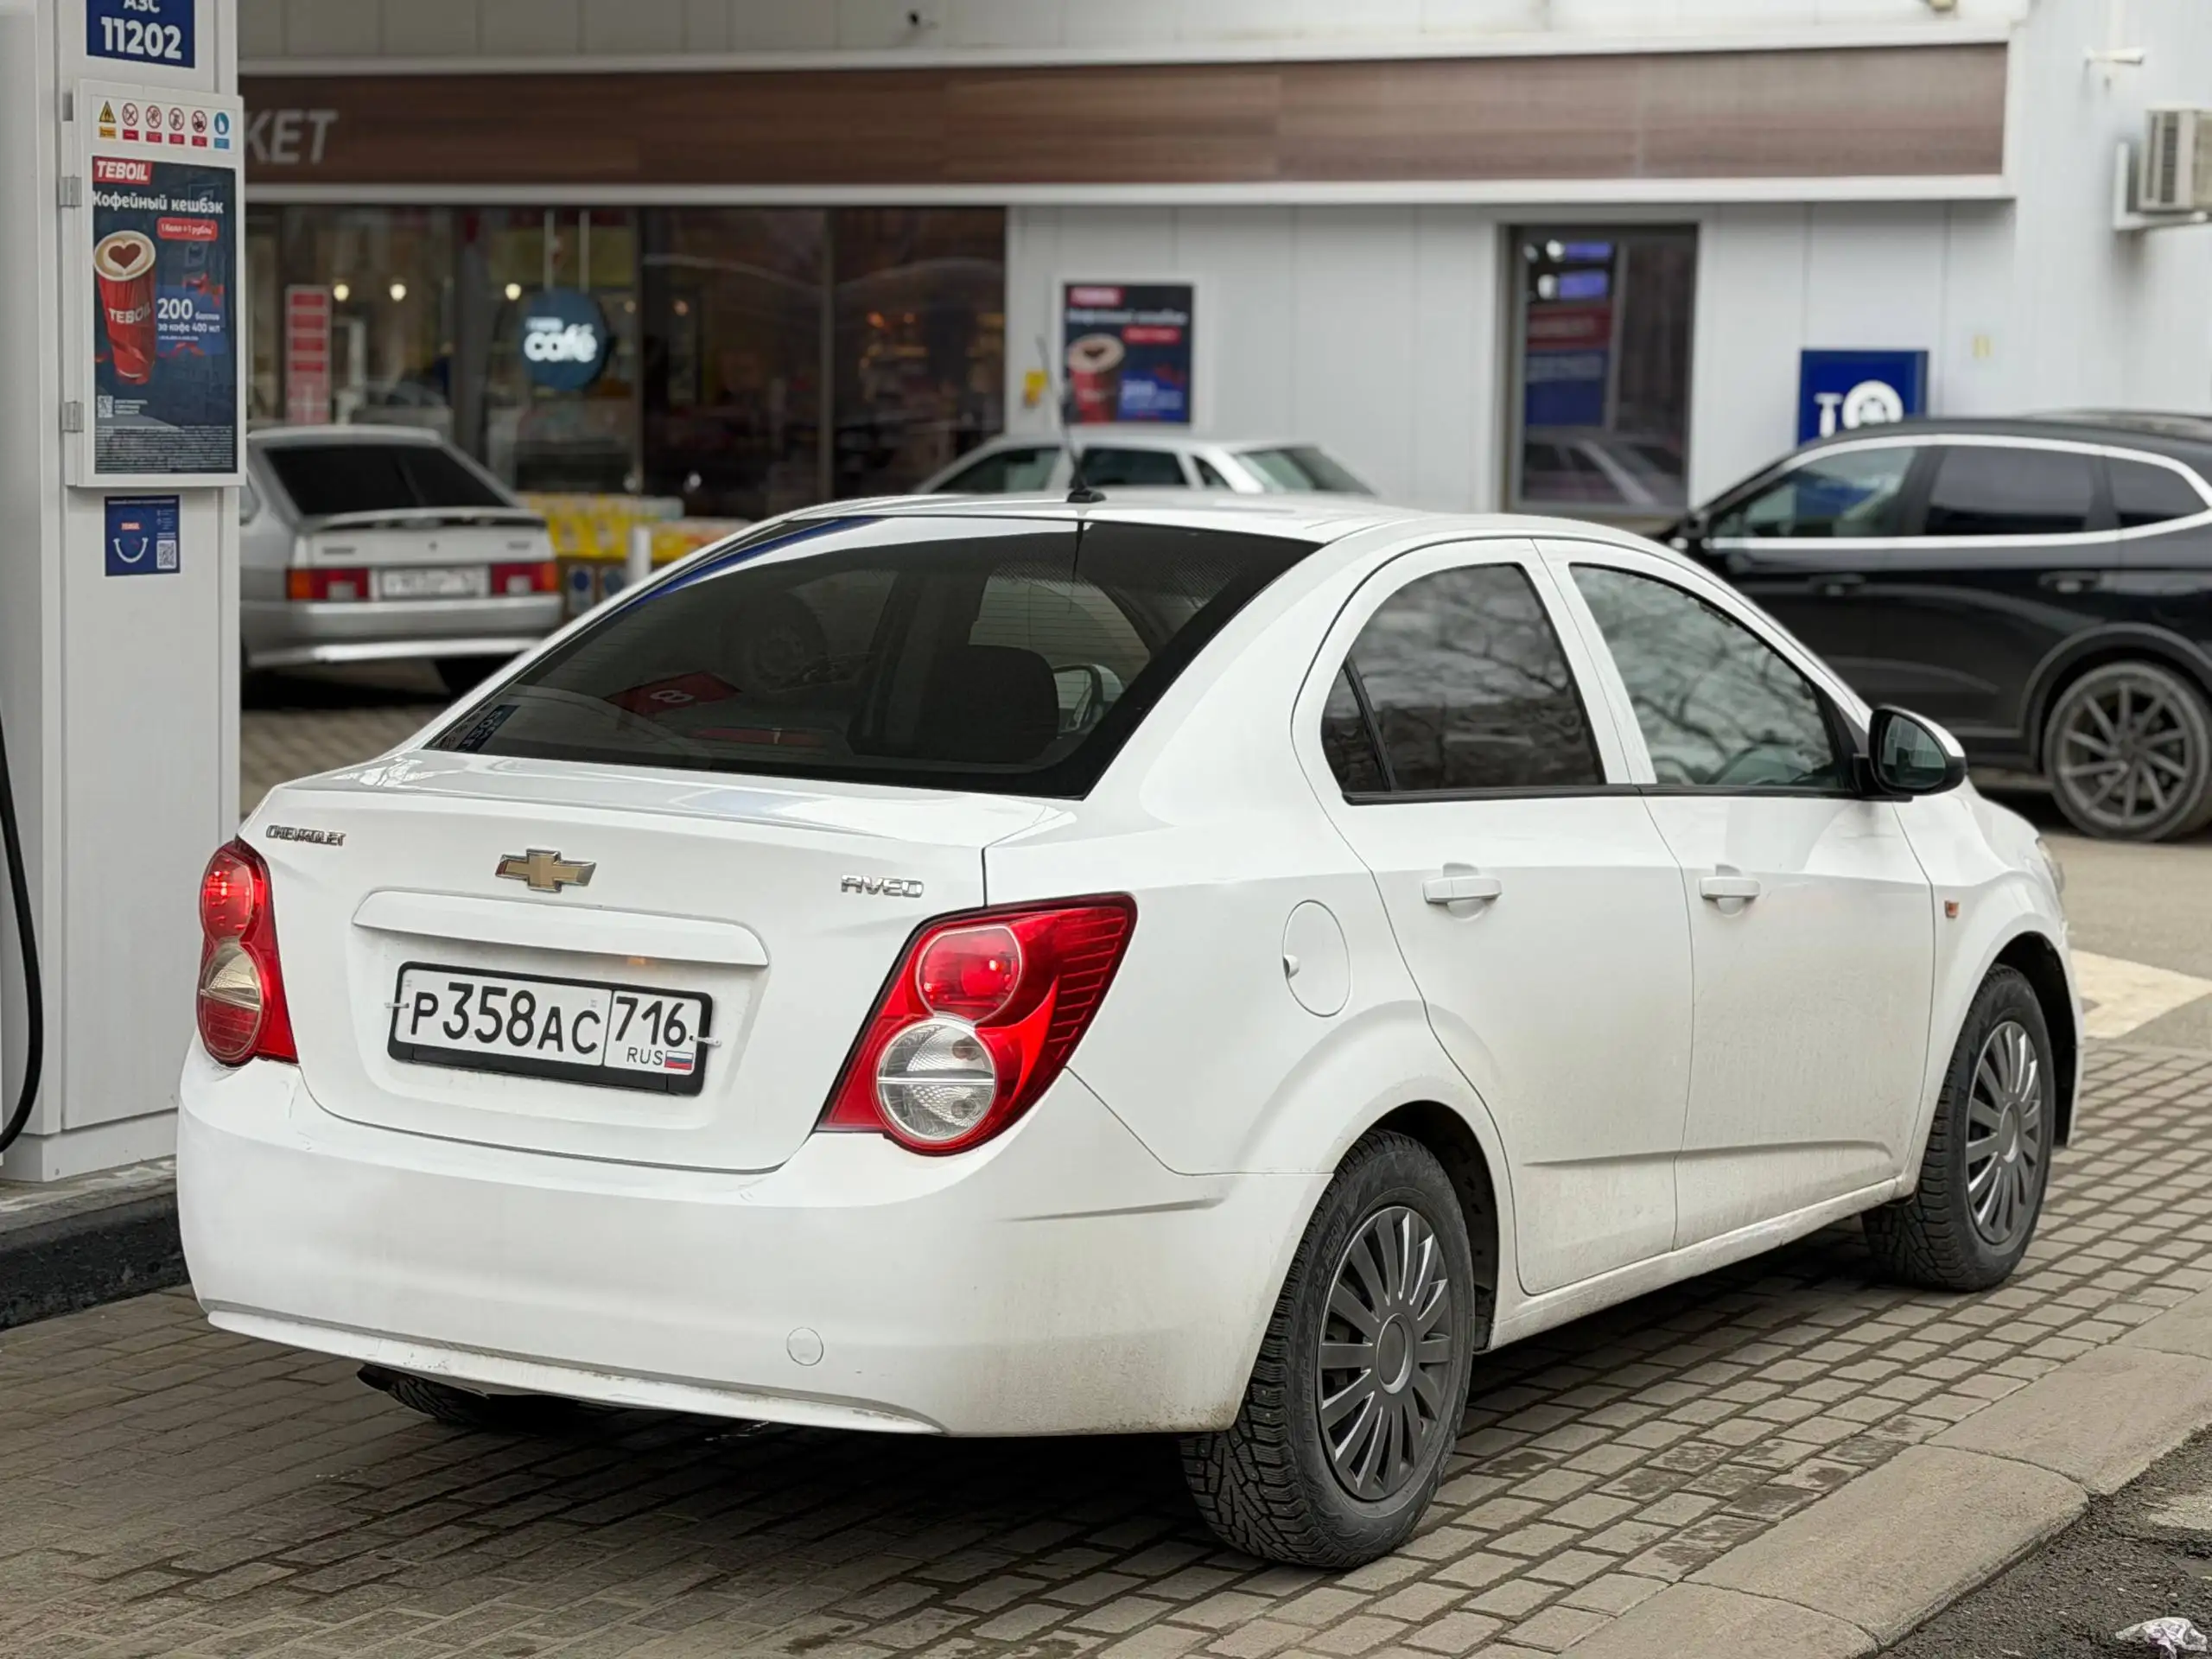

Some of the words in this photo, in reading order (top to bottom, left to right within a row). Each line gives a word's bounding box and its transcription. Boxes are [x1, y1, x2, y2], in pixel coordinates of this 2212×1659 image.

[100, 16, 182, 60] 11202
[97, 161, 149, 181] TEBOIL
[92, 191, 168, 212] Кофейный
[171, 197, 224, 214] кешбэк
[158, 298, 193, 320] 200
[266, 825, 346, 846] CHEVROLET
[842, 874, 924, 898] AVEO
[615, 996, 687, 1047] 716
[626, 1047, 664, 1065] RUS
